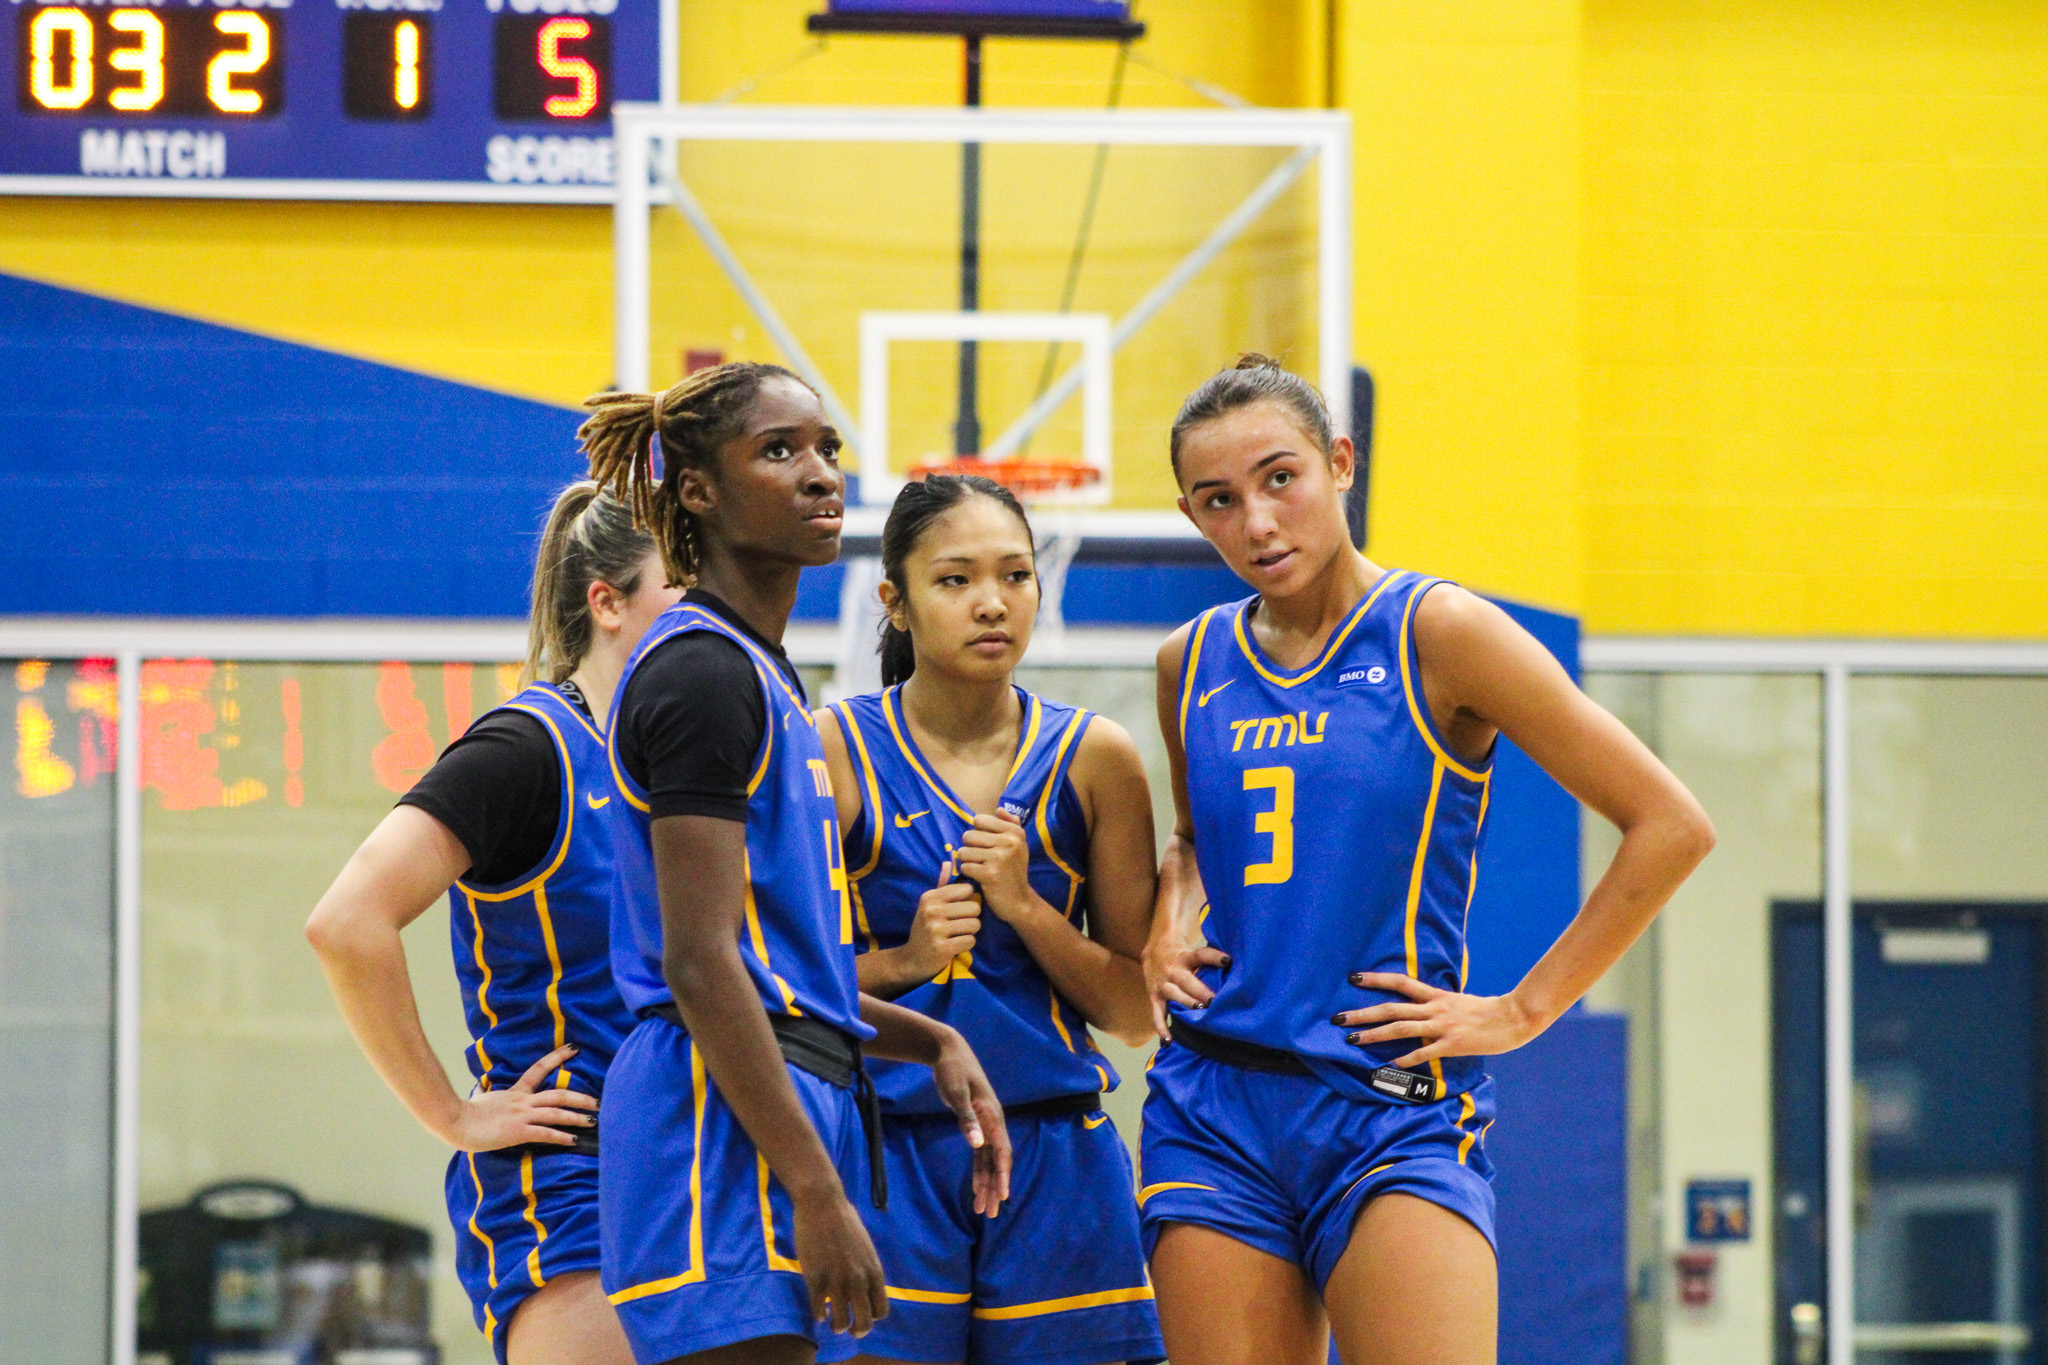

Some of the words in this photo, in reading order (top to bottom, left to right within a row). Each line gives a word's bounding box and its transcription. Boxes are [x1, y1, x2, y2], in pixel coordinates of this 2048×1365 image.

[394, 20, 420, 109] 1
[537, 17, 598, 117] 5
[80, 129, 227, 177] MATCH
[1338, 670, 1366, 683] BMO
[1230, 711, 1329, 752] TMU
[1243, 766, 1295, 887] 3
[1414, 1083, 1429, 1096] M
